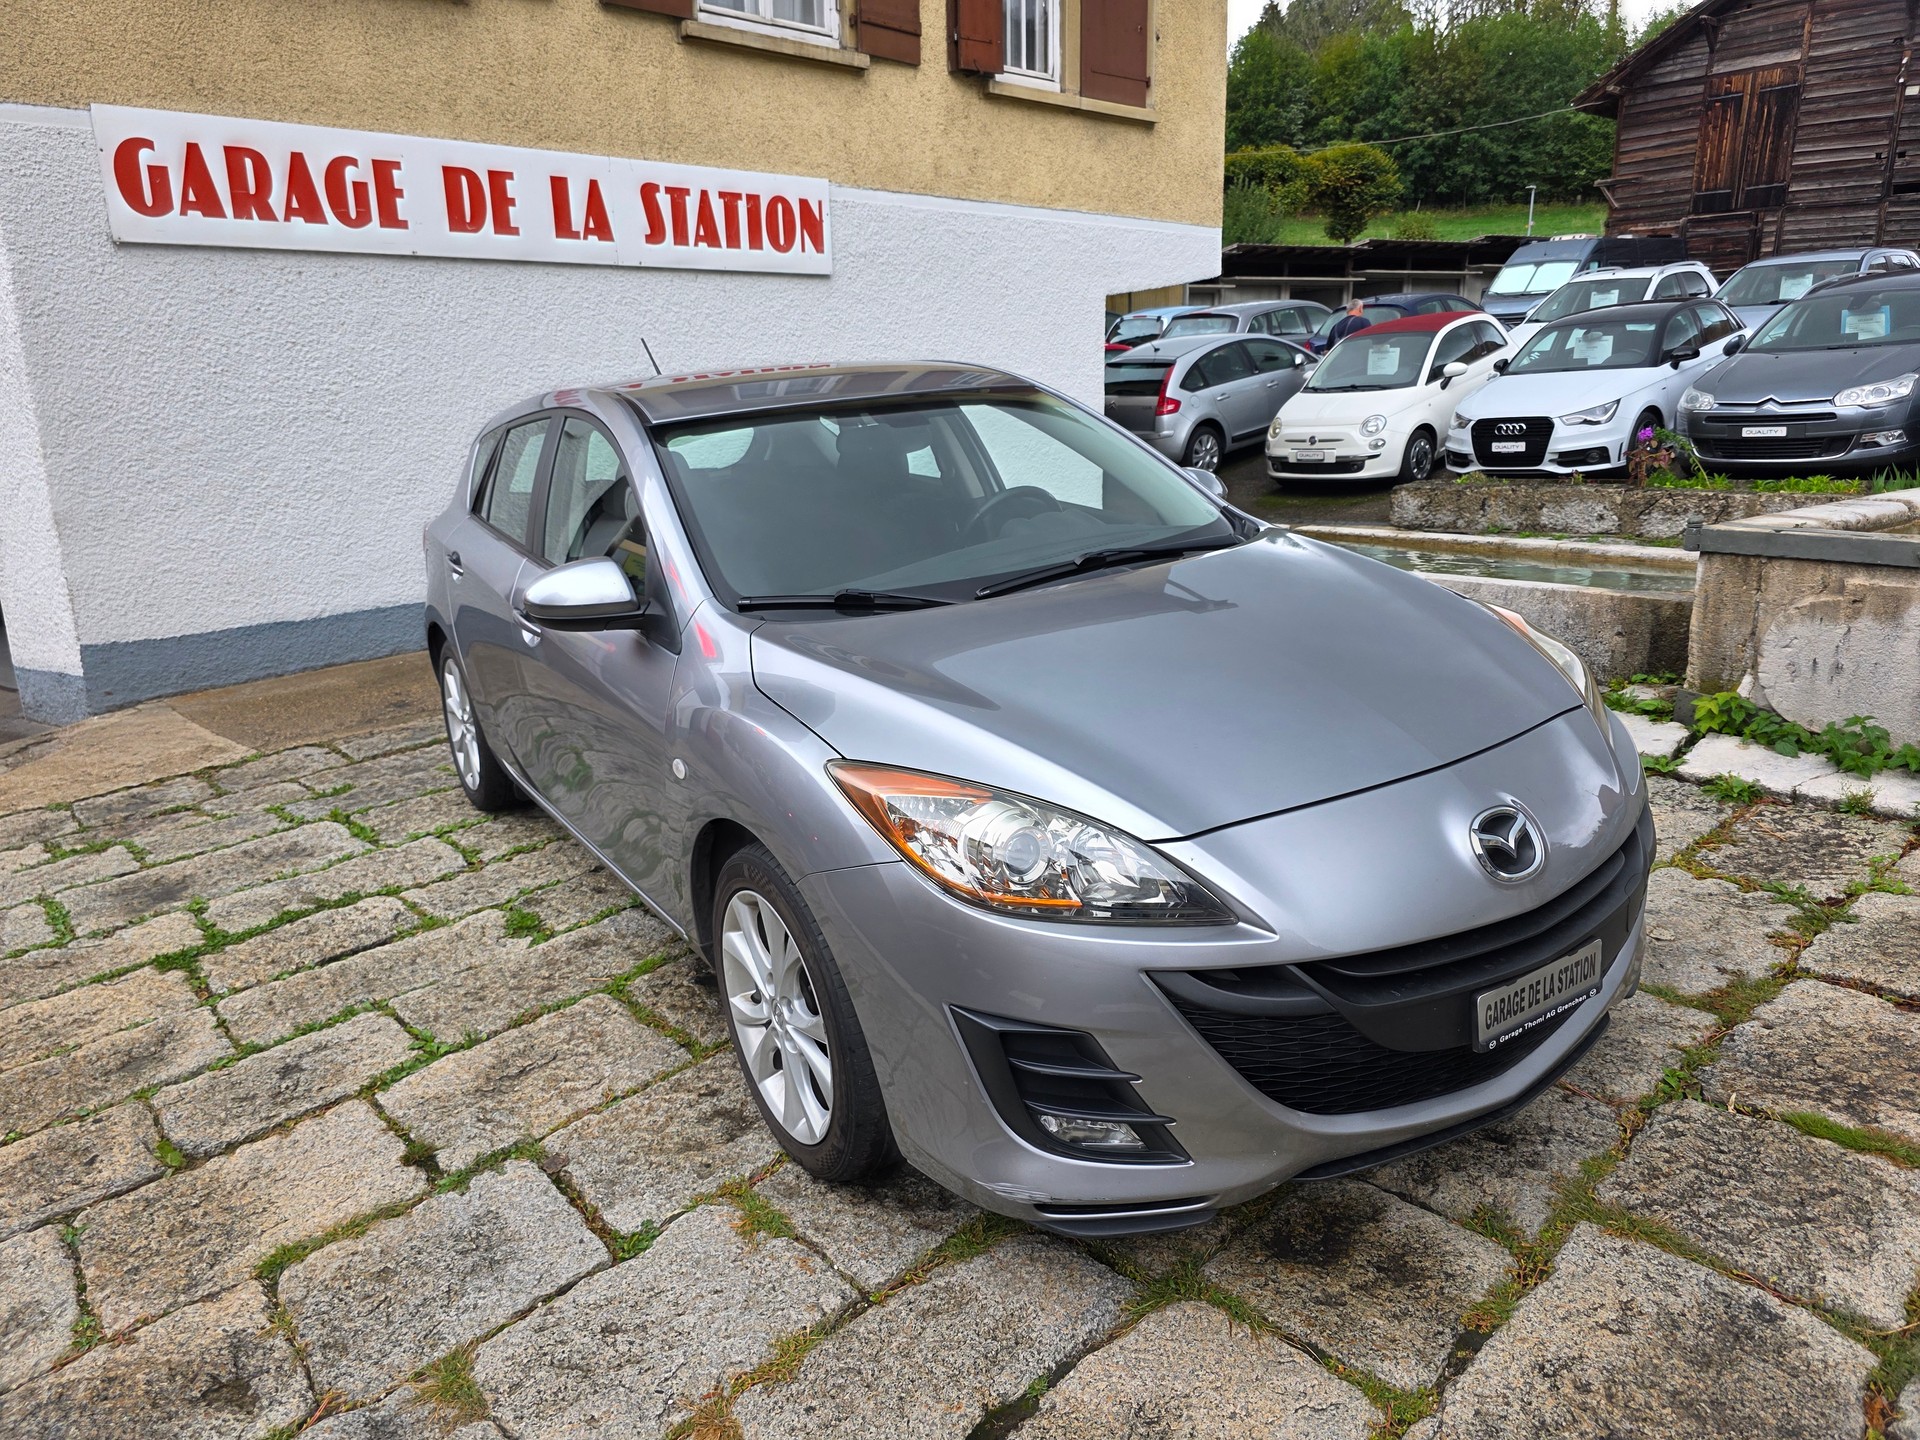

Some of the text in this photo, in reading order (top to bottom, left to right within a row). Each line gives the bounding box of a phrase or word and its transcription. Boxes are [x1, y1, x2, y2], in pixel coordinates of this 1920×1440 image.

[113, 137, 825, 254] GARAGE DE LA STATION
[1485, 952, 1596, 1030] GARAGE DE LA STATION
[1499, 1027, 1523, 1043] Garage
[1545, 1009, 1556, 1019] AG
[1557, 994, 1587, 1013] Grenchen
